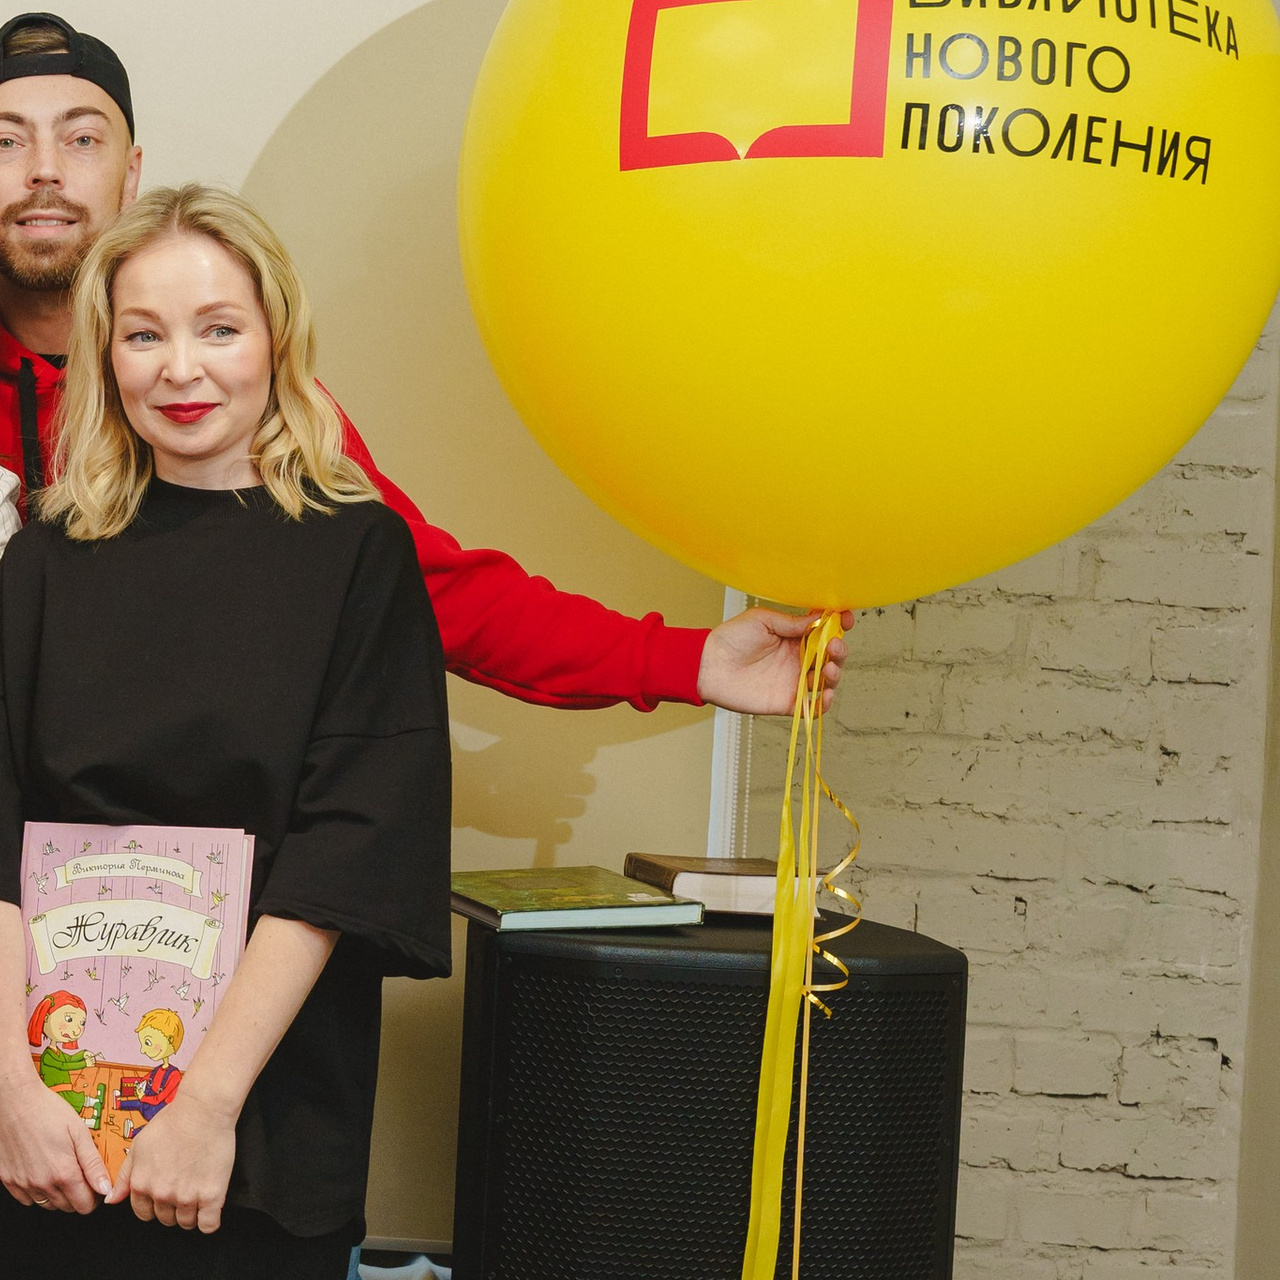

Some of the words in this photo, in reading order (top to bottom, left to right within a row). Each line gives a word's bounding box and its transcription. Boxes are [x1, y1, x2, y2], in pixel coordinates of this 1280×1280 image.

[905, 32, 1131, 94] НОВОГО
[900, 102, 1212, 186] ПОКОЛЕНИЯ
[72, 862, 126, 875] Виктория
[129, 858, 185, 880] Перминова
[52, 911, 199, 954] Журавлик
